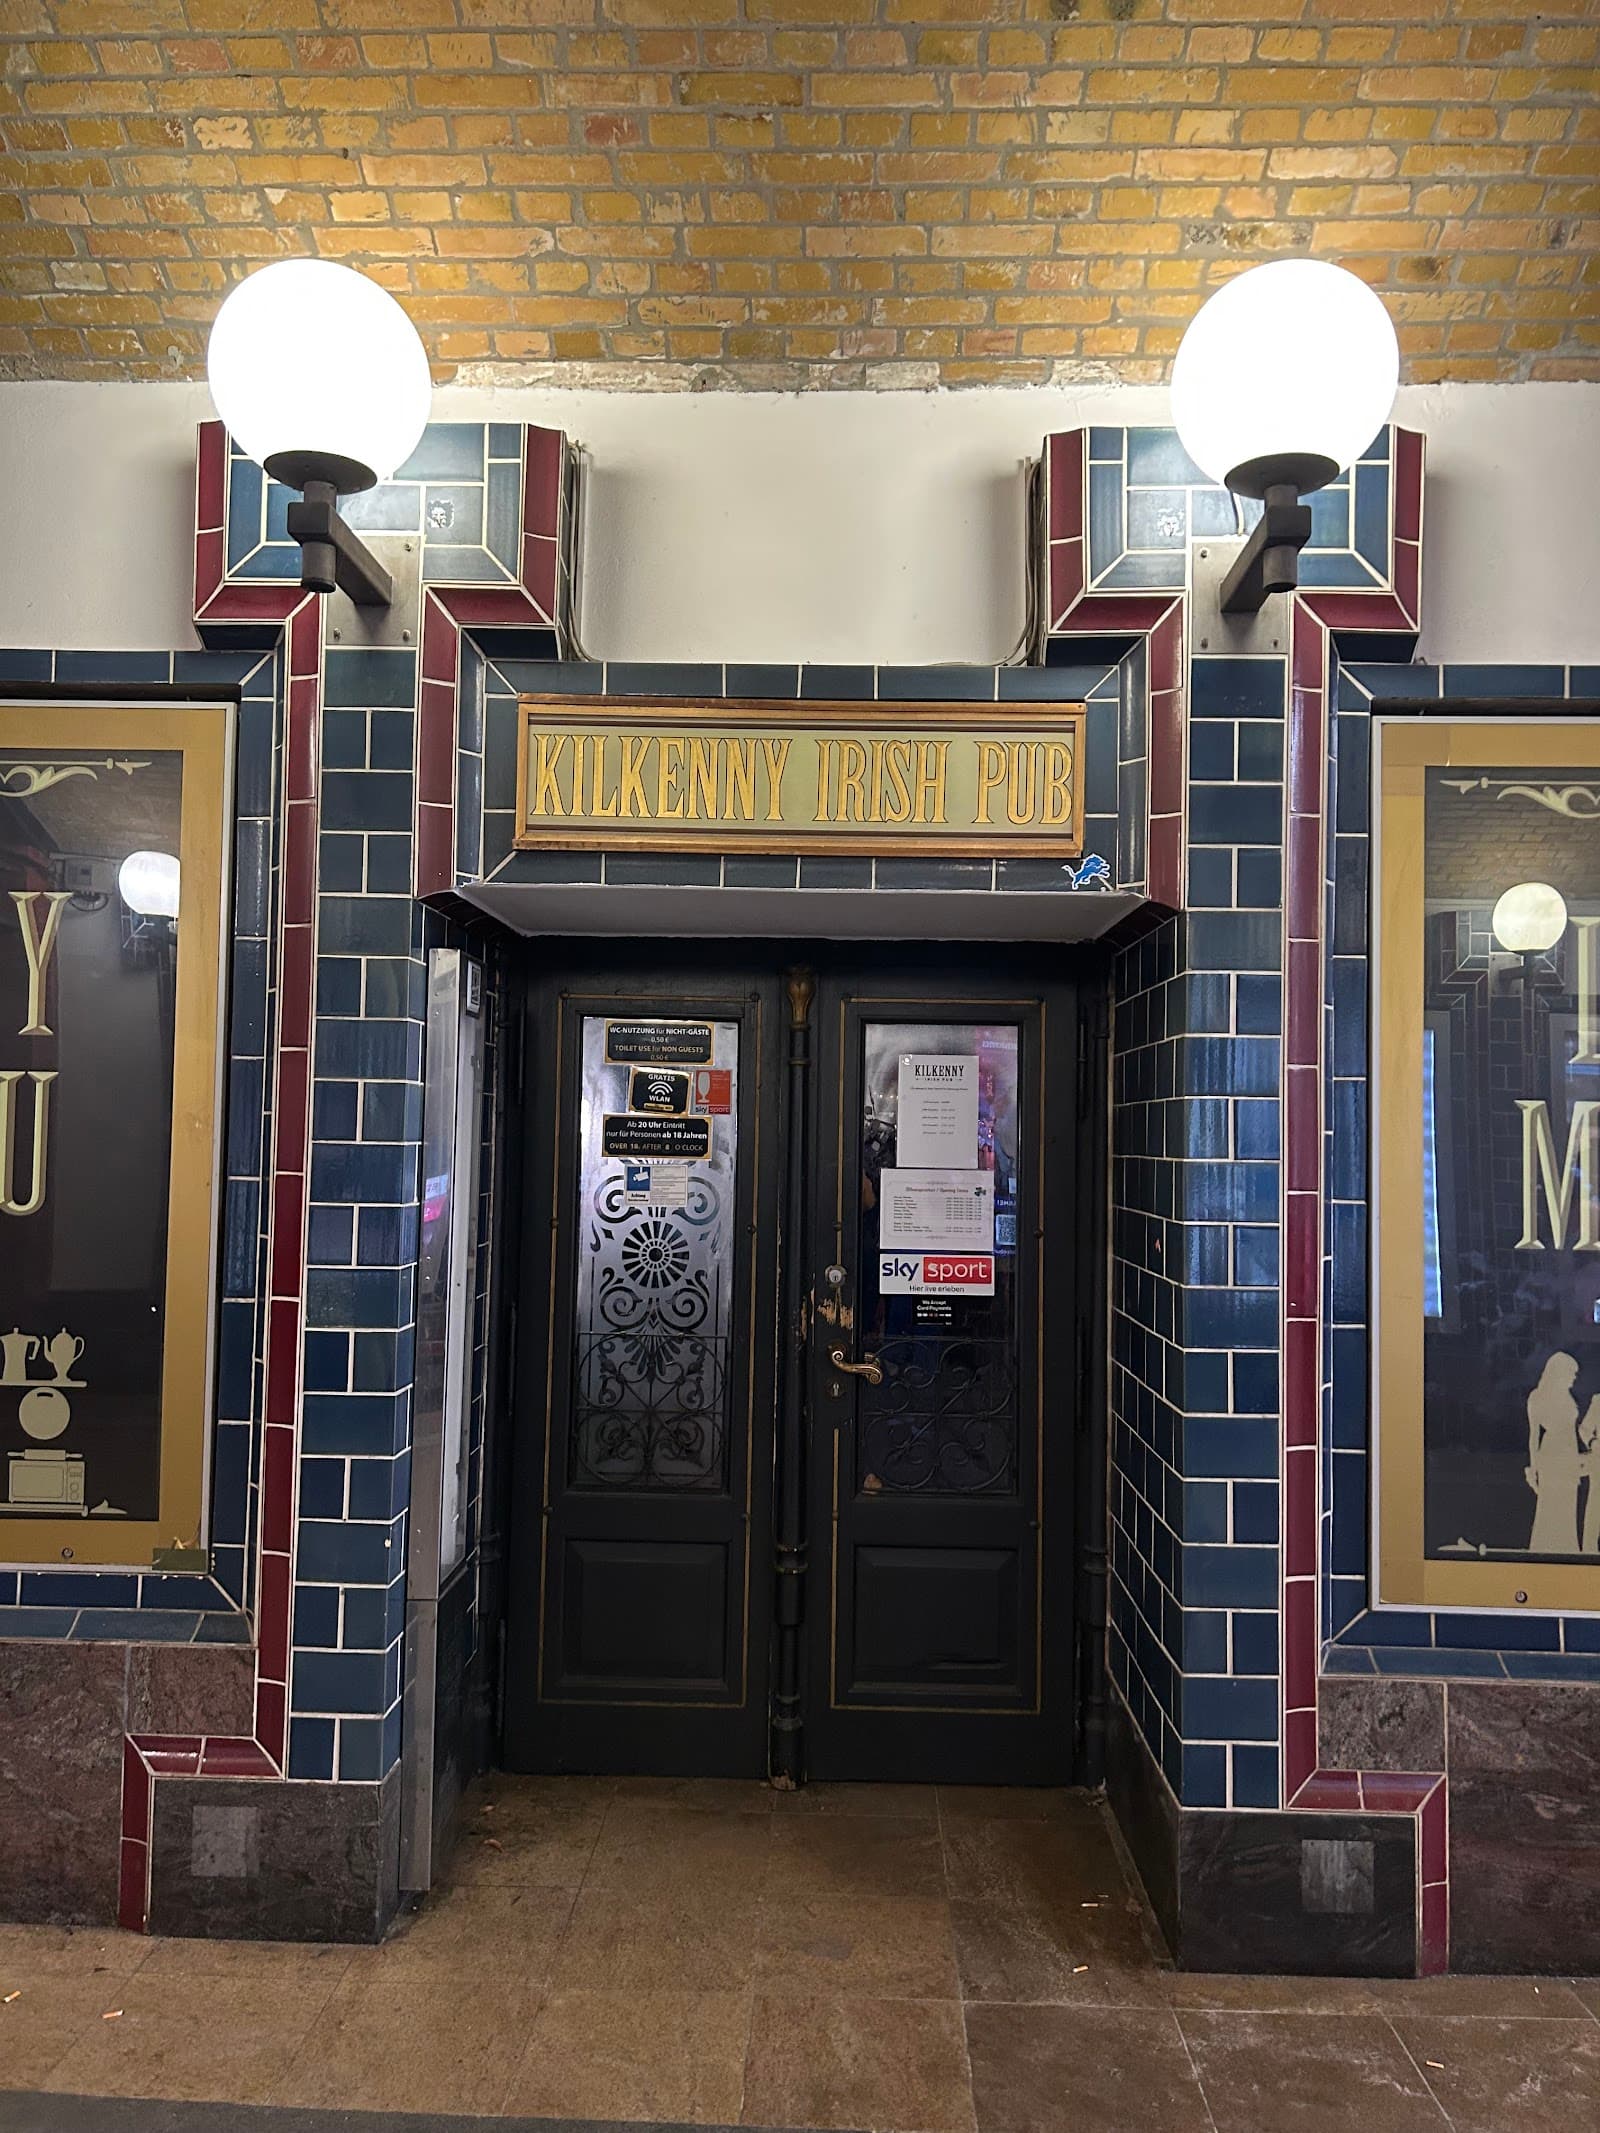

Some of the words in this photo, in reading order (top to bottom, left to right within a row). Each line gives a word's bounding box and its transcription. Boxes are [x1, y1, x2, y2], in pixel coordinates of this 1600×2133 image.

[531, 734, 792, 821] KILKENNY
[812, 739, 952, 823] IRISH
[971, 741, 1073, 824] PUB
[8, 891, 73, 1036] Y
[915, 1065, 964, 1076] KILKENNY
[648, 1073, 675, 1082] GRATIS
[649, 1095, 670, 1103] WLAN
[695, 1105, 707, 1114] sky
[648, 1121, 661, 1129] Uhr
[630, 1130, 660, 1138] Personen
[673, 1131, 682, 1139] 18
[0, 1071, 59, 1216] U
[1514, 1100, 1600, 1250] M
[882, 1258, 919, 1281] sky
[927, 1261, 988, 1281] sport
[938, 1285, 965, 1293] erleben
